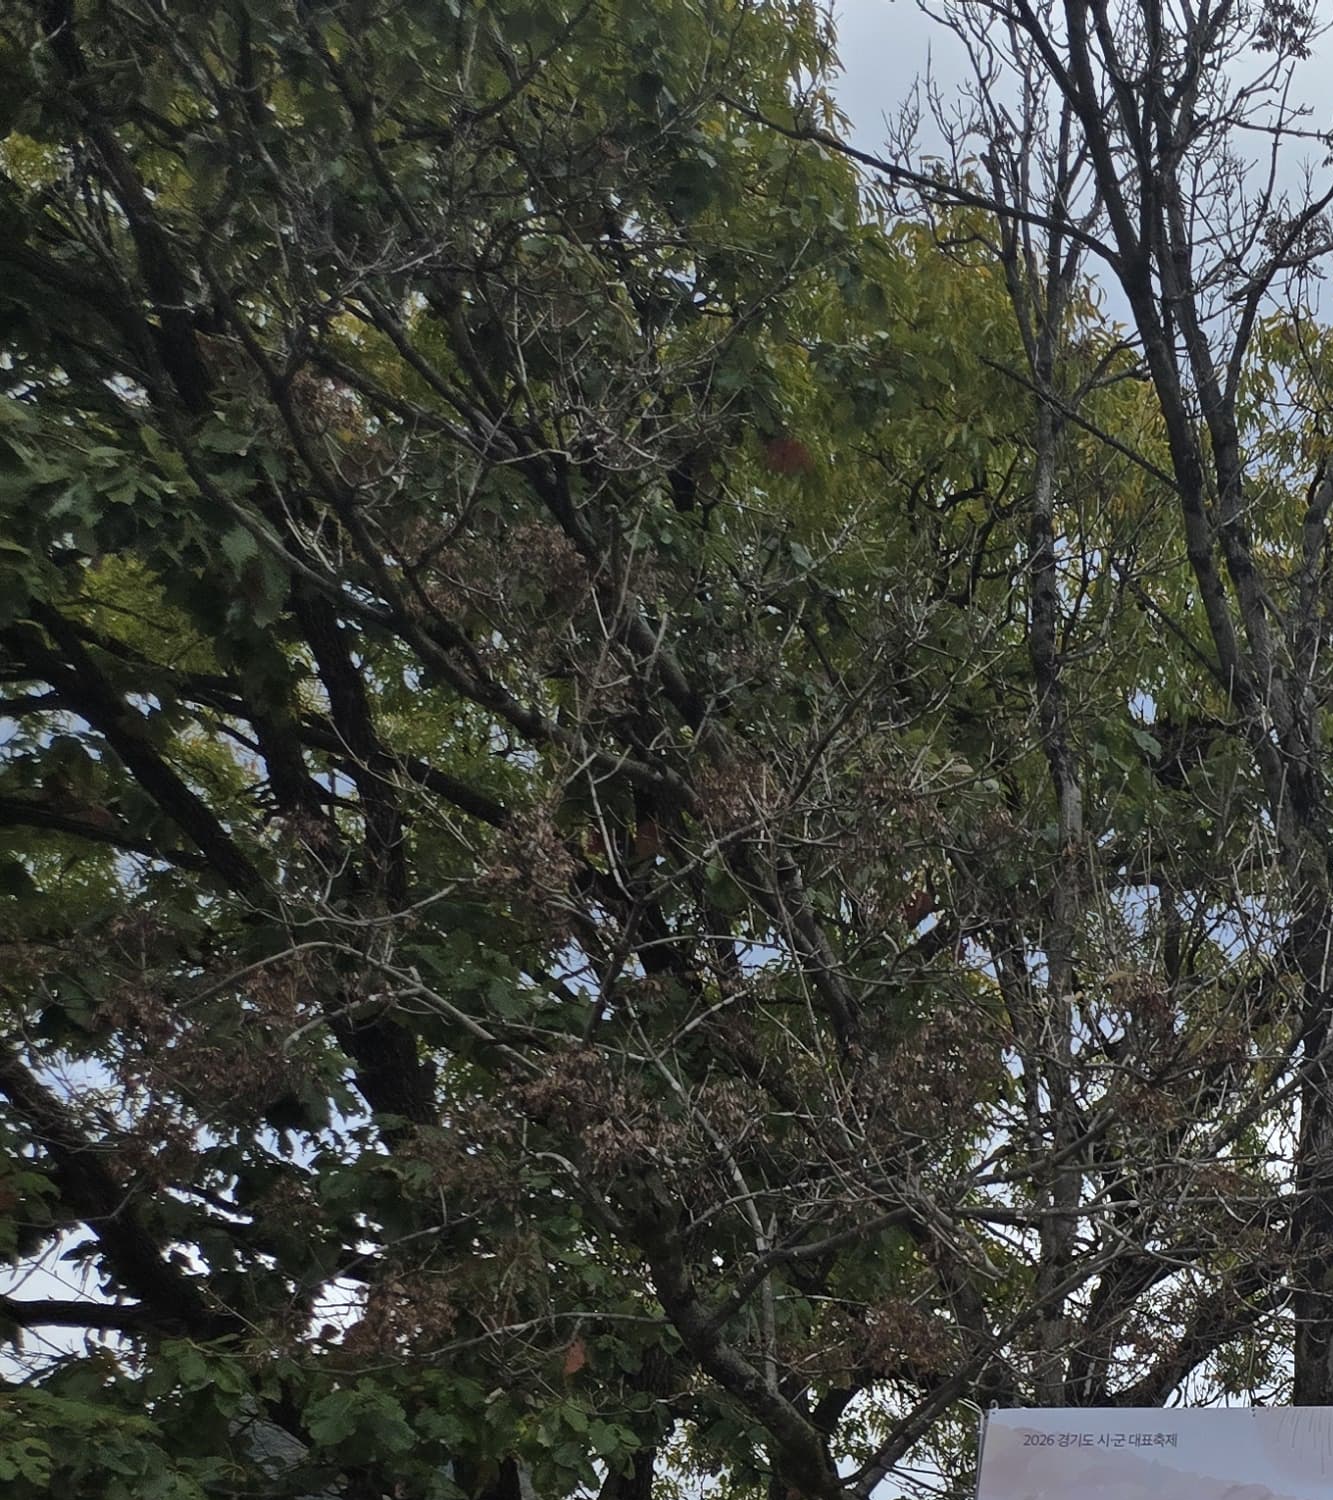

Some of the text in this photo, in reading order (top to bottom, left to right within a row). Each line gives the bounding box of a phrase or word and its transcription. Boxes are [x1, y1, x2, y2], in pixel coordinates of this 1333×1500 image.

[1023, 1434, 1054, 1447] 2026
[1057, 1433, 1094, 1448] 경기도
[1128, 1433, 1178, 1447] 대표축제
